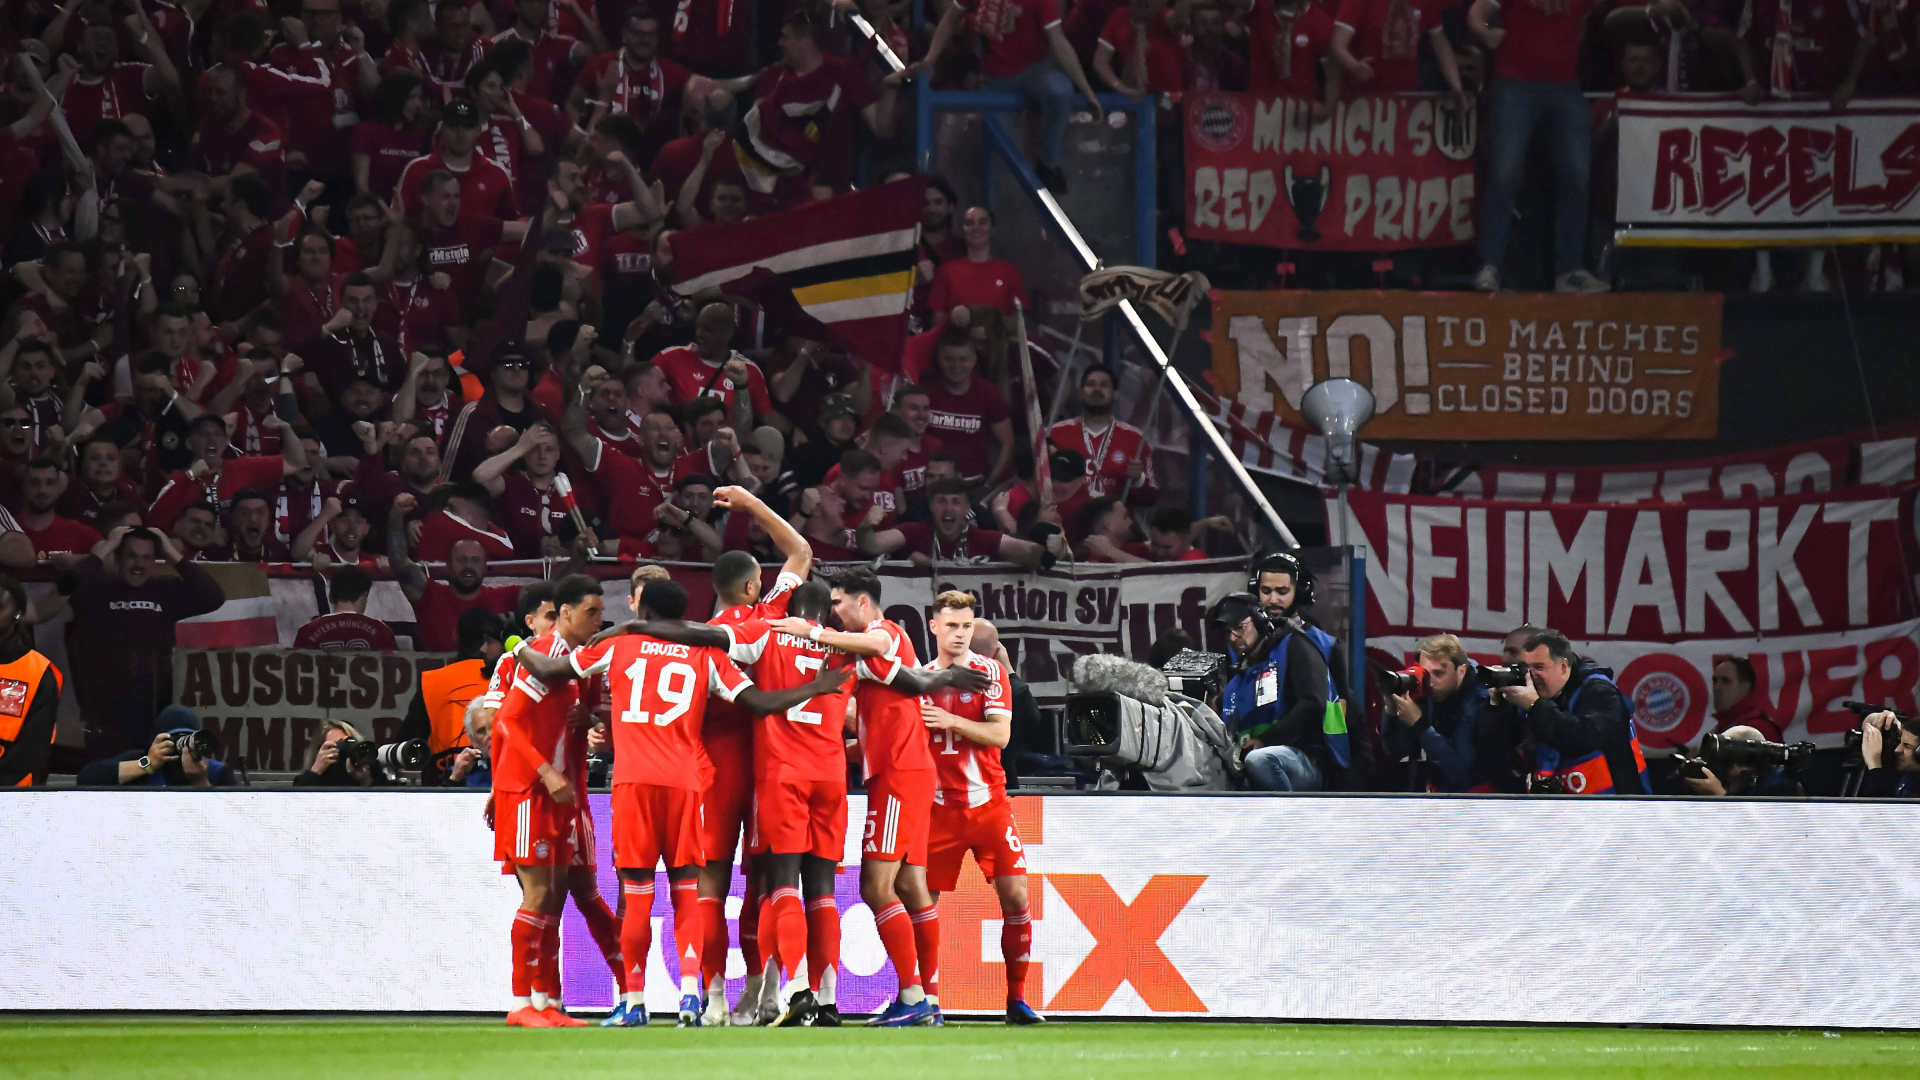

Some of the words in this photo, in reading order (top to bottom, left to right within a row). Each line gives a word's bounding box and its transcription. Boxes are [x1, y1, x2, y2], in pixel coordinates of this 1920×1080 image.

[1652, 123, 1920, 216] REBELS
[1194, 166, 1277, 233] RED
[1343, 173, 1476, 241] PRIDE
[1228, 314, 1432, 415] NO!
[1437, 316, 1487, 347] TO
[1509, 319, 1700, 355] MATCHES
[1503, 352, 1634, 384] BEHIND
[1437, 384, 1569, 415] CLOSED
[1586, 386, 1695, 418] DOORS
[1326, 497, 1900, 636] NEUMARKT
[938, 579, 1068, 622] ektion
[1075, 587, 1119, 624] SV
[640, 640, 691, 659] DAVIES
[180, 651, 457, 709] AUSGESP
[620, 657, 697, 727] 19
[787, 654, 830, 725] 2
[1005, 826, 1022, 853] 6
